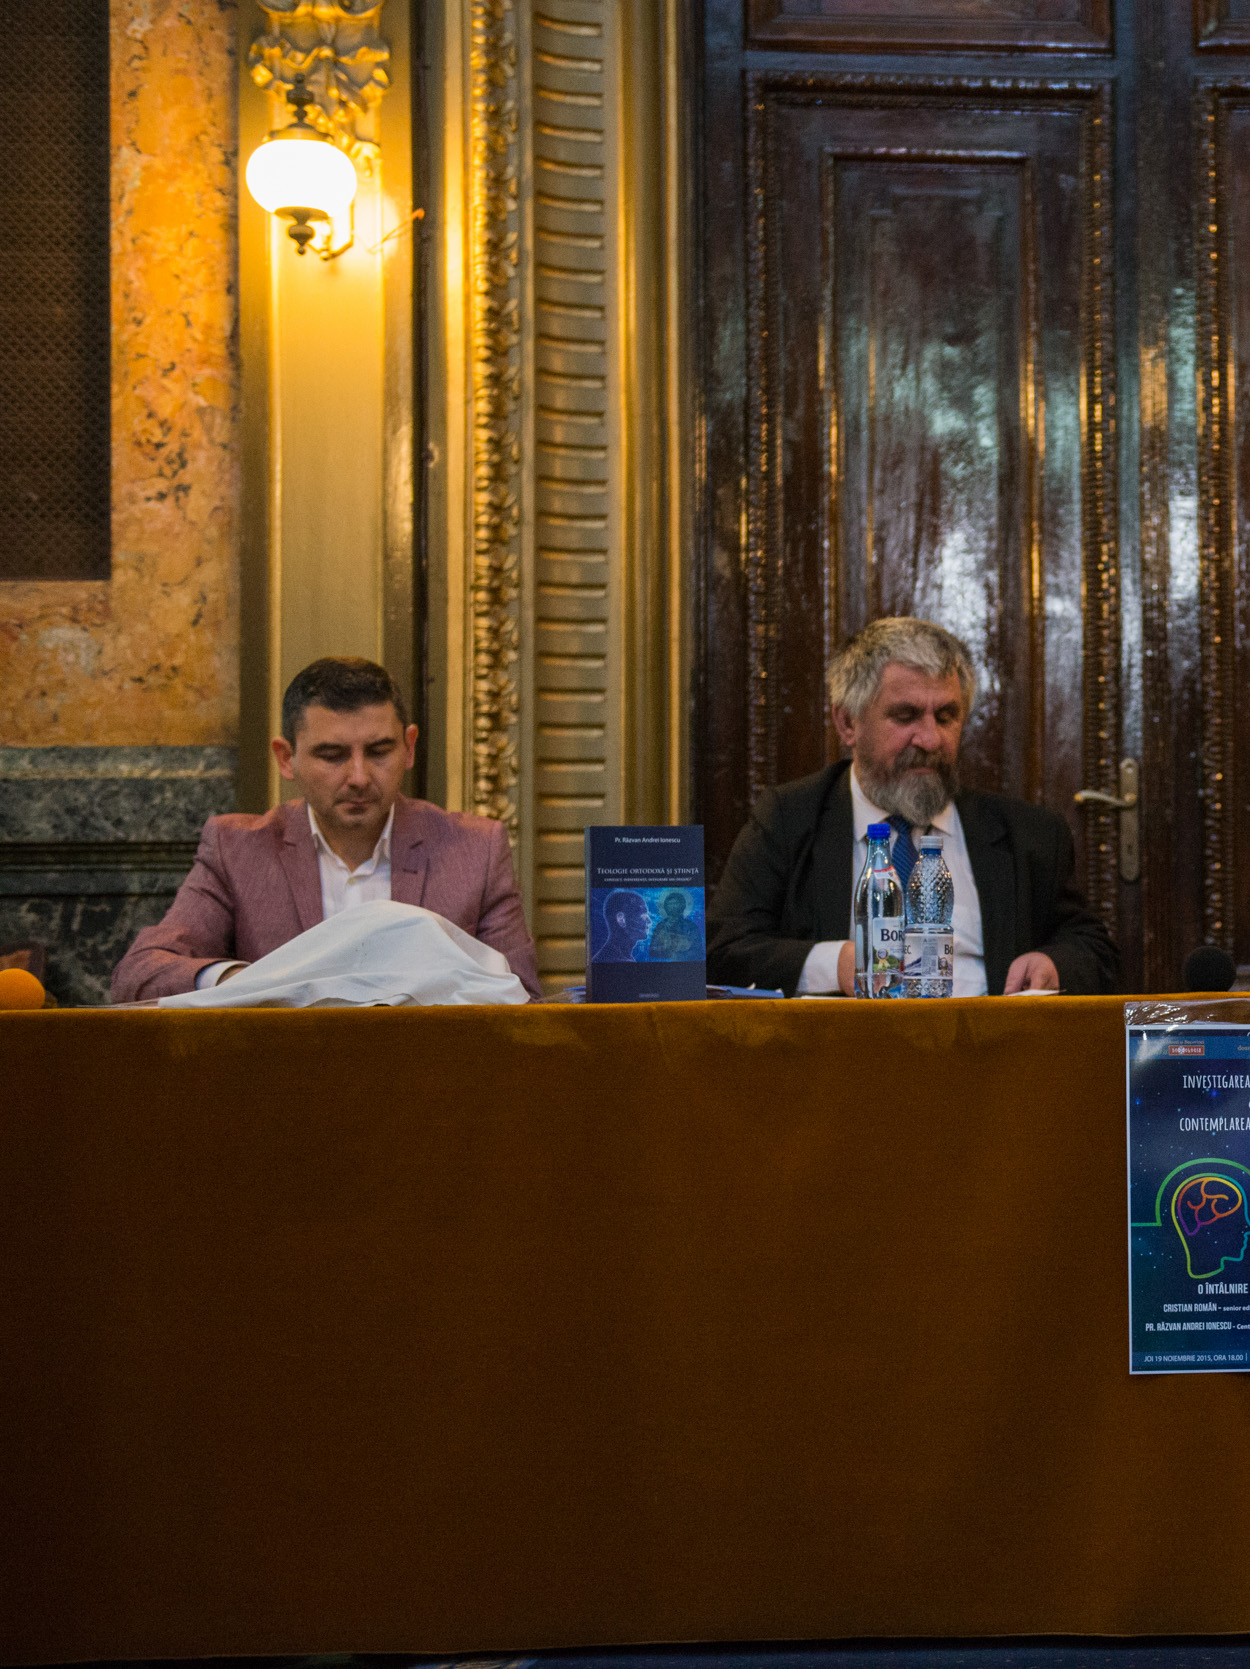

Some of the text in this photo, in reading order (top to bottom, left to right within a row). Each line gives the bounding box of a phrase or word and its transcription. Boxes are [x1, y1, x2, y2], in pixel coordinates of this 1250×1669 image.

[1182, 1074, 1250, 1089] INVESTIGAREA
[1179, 1117, 1250, 1132] CONTEMPLAREA
[1198, 1284, 1204, 1294] O
[1205, 1282, 1248, 1294] ÎNTÂLNIRE
[1164, 1304, 1192, 1312] CRISTIAN
[1145, 1323, 1156, 1332] PR.
[1157, 1322, 1180, 1332] RĂZVAN
[1182, 1322, 1204, 1330] ANDREI
[1206, 1322, 1232, 1330] IONESCU
